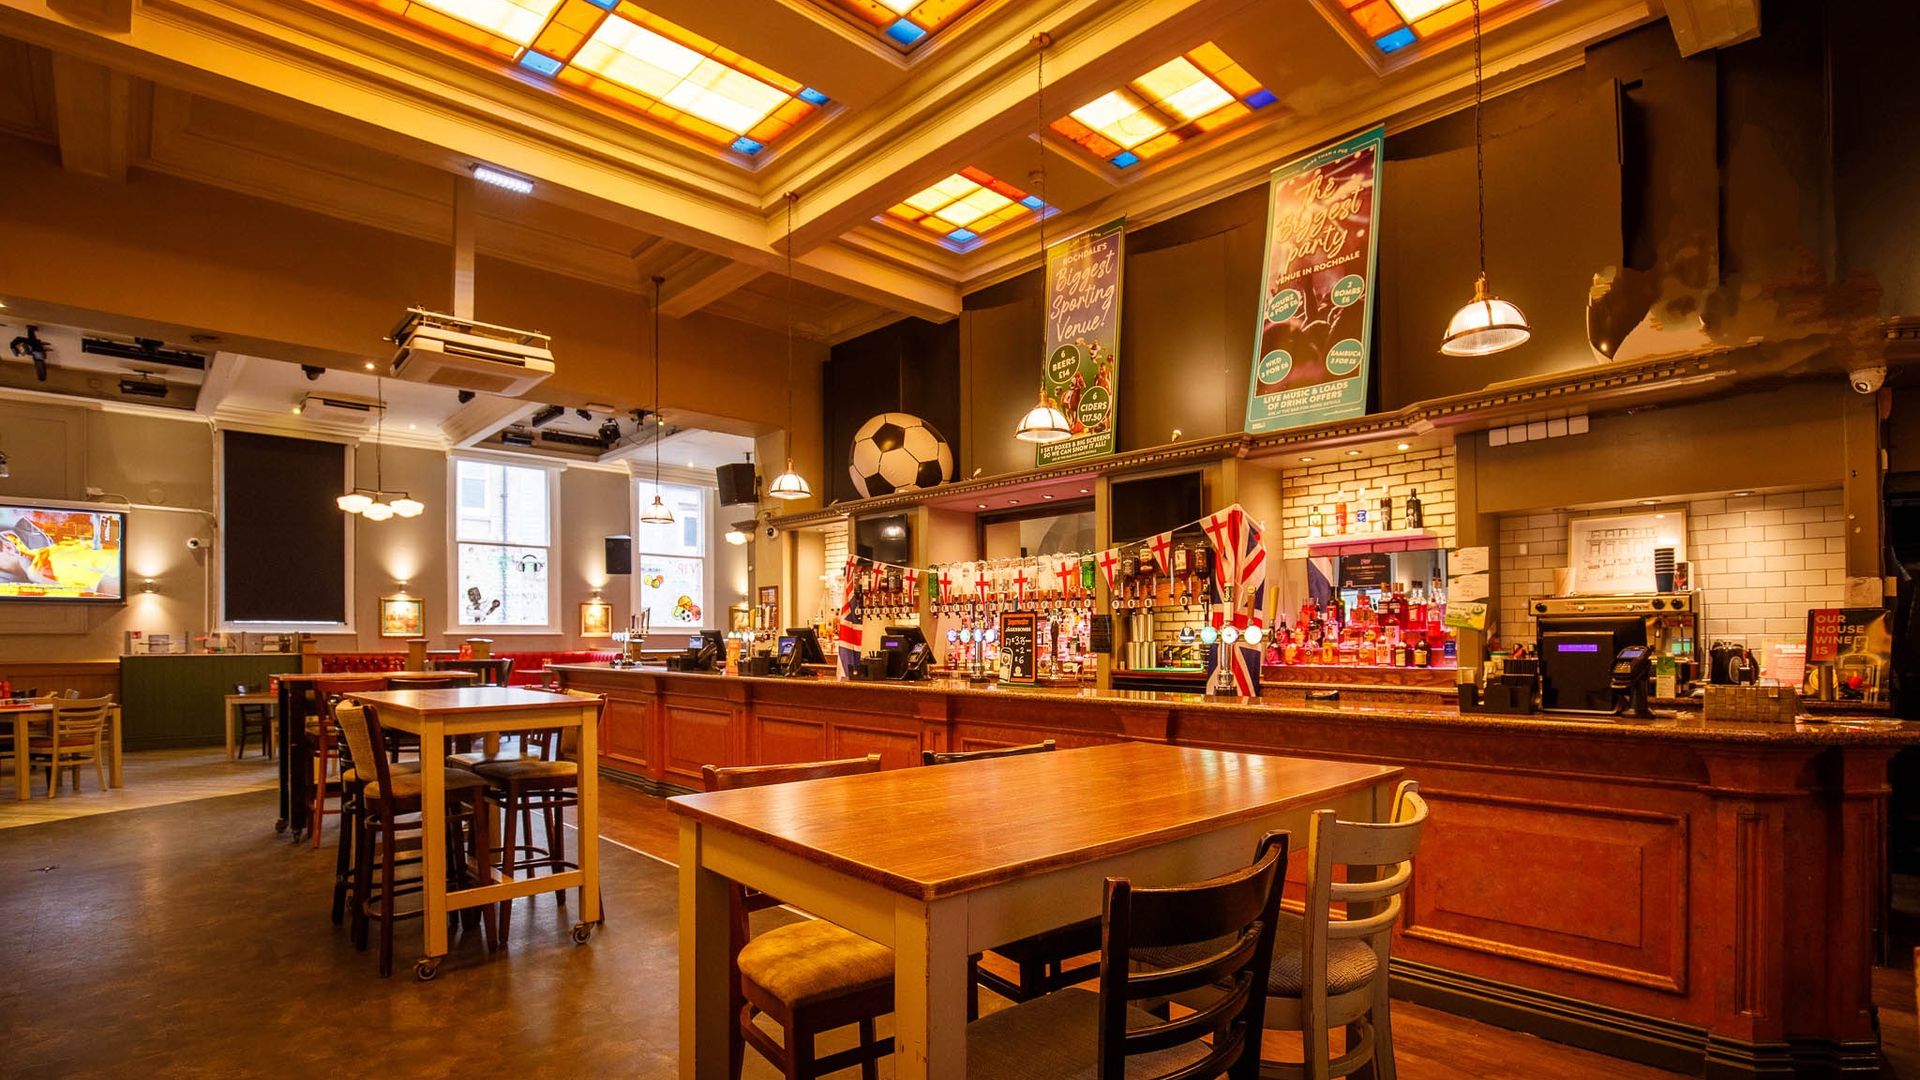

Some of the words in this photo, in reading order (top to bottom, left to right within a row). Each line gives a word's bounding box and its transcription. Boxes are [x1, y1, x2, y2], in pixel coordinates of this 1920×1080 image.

[1296, 174, 1335, 211] The
[1277, 187, 1364, 243] Biggest
[1284, 224, 1348, 274] party
[1056, 249, 1115, 296] Biggest
[1275, 270, 1301, 286] VENUE
[1302, 267, 1312, 276] IN
[1314, 250, 1360, 272] ROCHDALE
[1050, 285, 1115, 323] Sporting
[1056, 310, 1106, 342] Venue!
[1060, 350, 1066, 358] 6
[1052, 356, 1076, 372] BEERS
[1266, 365, 1280, 376] FOR
[1058, 369, 1070, 380] £14
[1092, 392, 1097, 400] 6
[1264, 395, 1281, 404] LIVE
[1283, 389, 1310, 401] MUSIC
[1319, 381, 1348, 394] LOADS
[1268, 402, 1280, 411] OF
[1281, 398, 1308, 409] DRINK
[1309, 390, 1343, 403] OFFERS
[1080, 401, 1107, 412] CIDERS
[1082, 413, 1102, 422] £17.50
[1054, 442, 1071, 451] BOXES
[1086, 433, 1111, 444] SCREENS
[1816, 615, 1846, 623] OUR
[1815, 625, 1864, 634] HOUSE
[1815, 635, 1852, 644] WINE
[1816, 646, 1828, 655] IS
